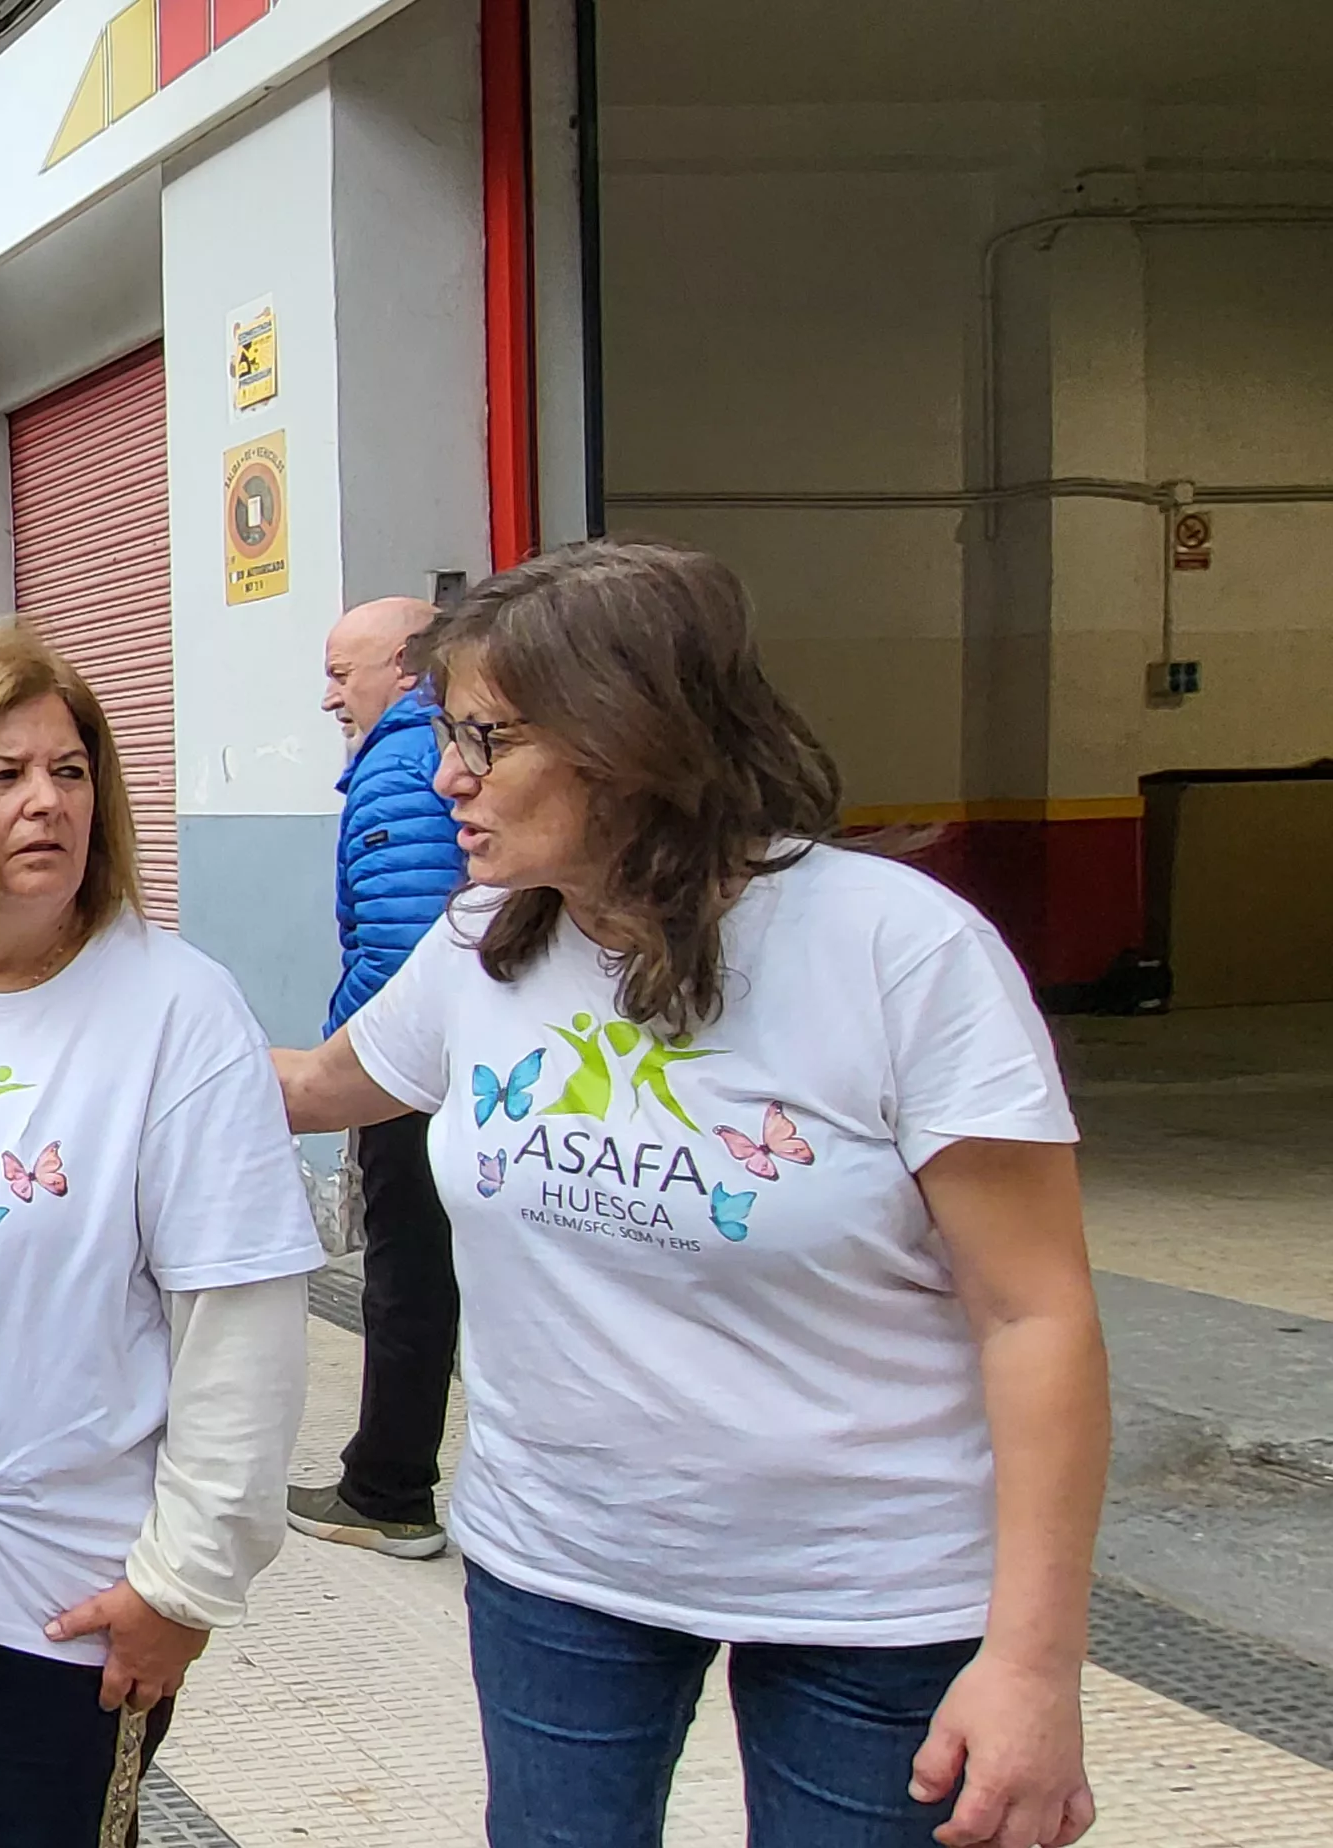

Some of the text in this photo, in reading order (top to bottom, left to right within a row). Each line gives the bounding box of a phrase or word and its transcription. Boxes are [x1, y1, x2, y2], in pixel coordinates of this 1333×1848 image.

[513, 1124, 708, 1196] ASAFA
[541, 1180, 674, 1231] HUESCA
[619, 1226, 654, 1244] SQM
[669, 1237, 701, 1252] EHS
